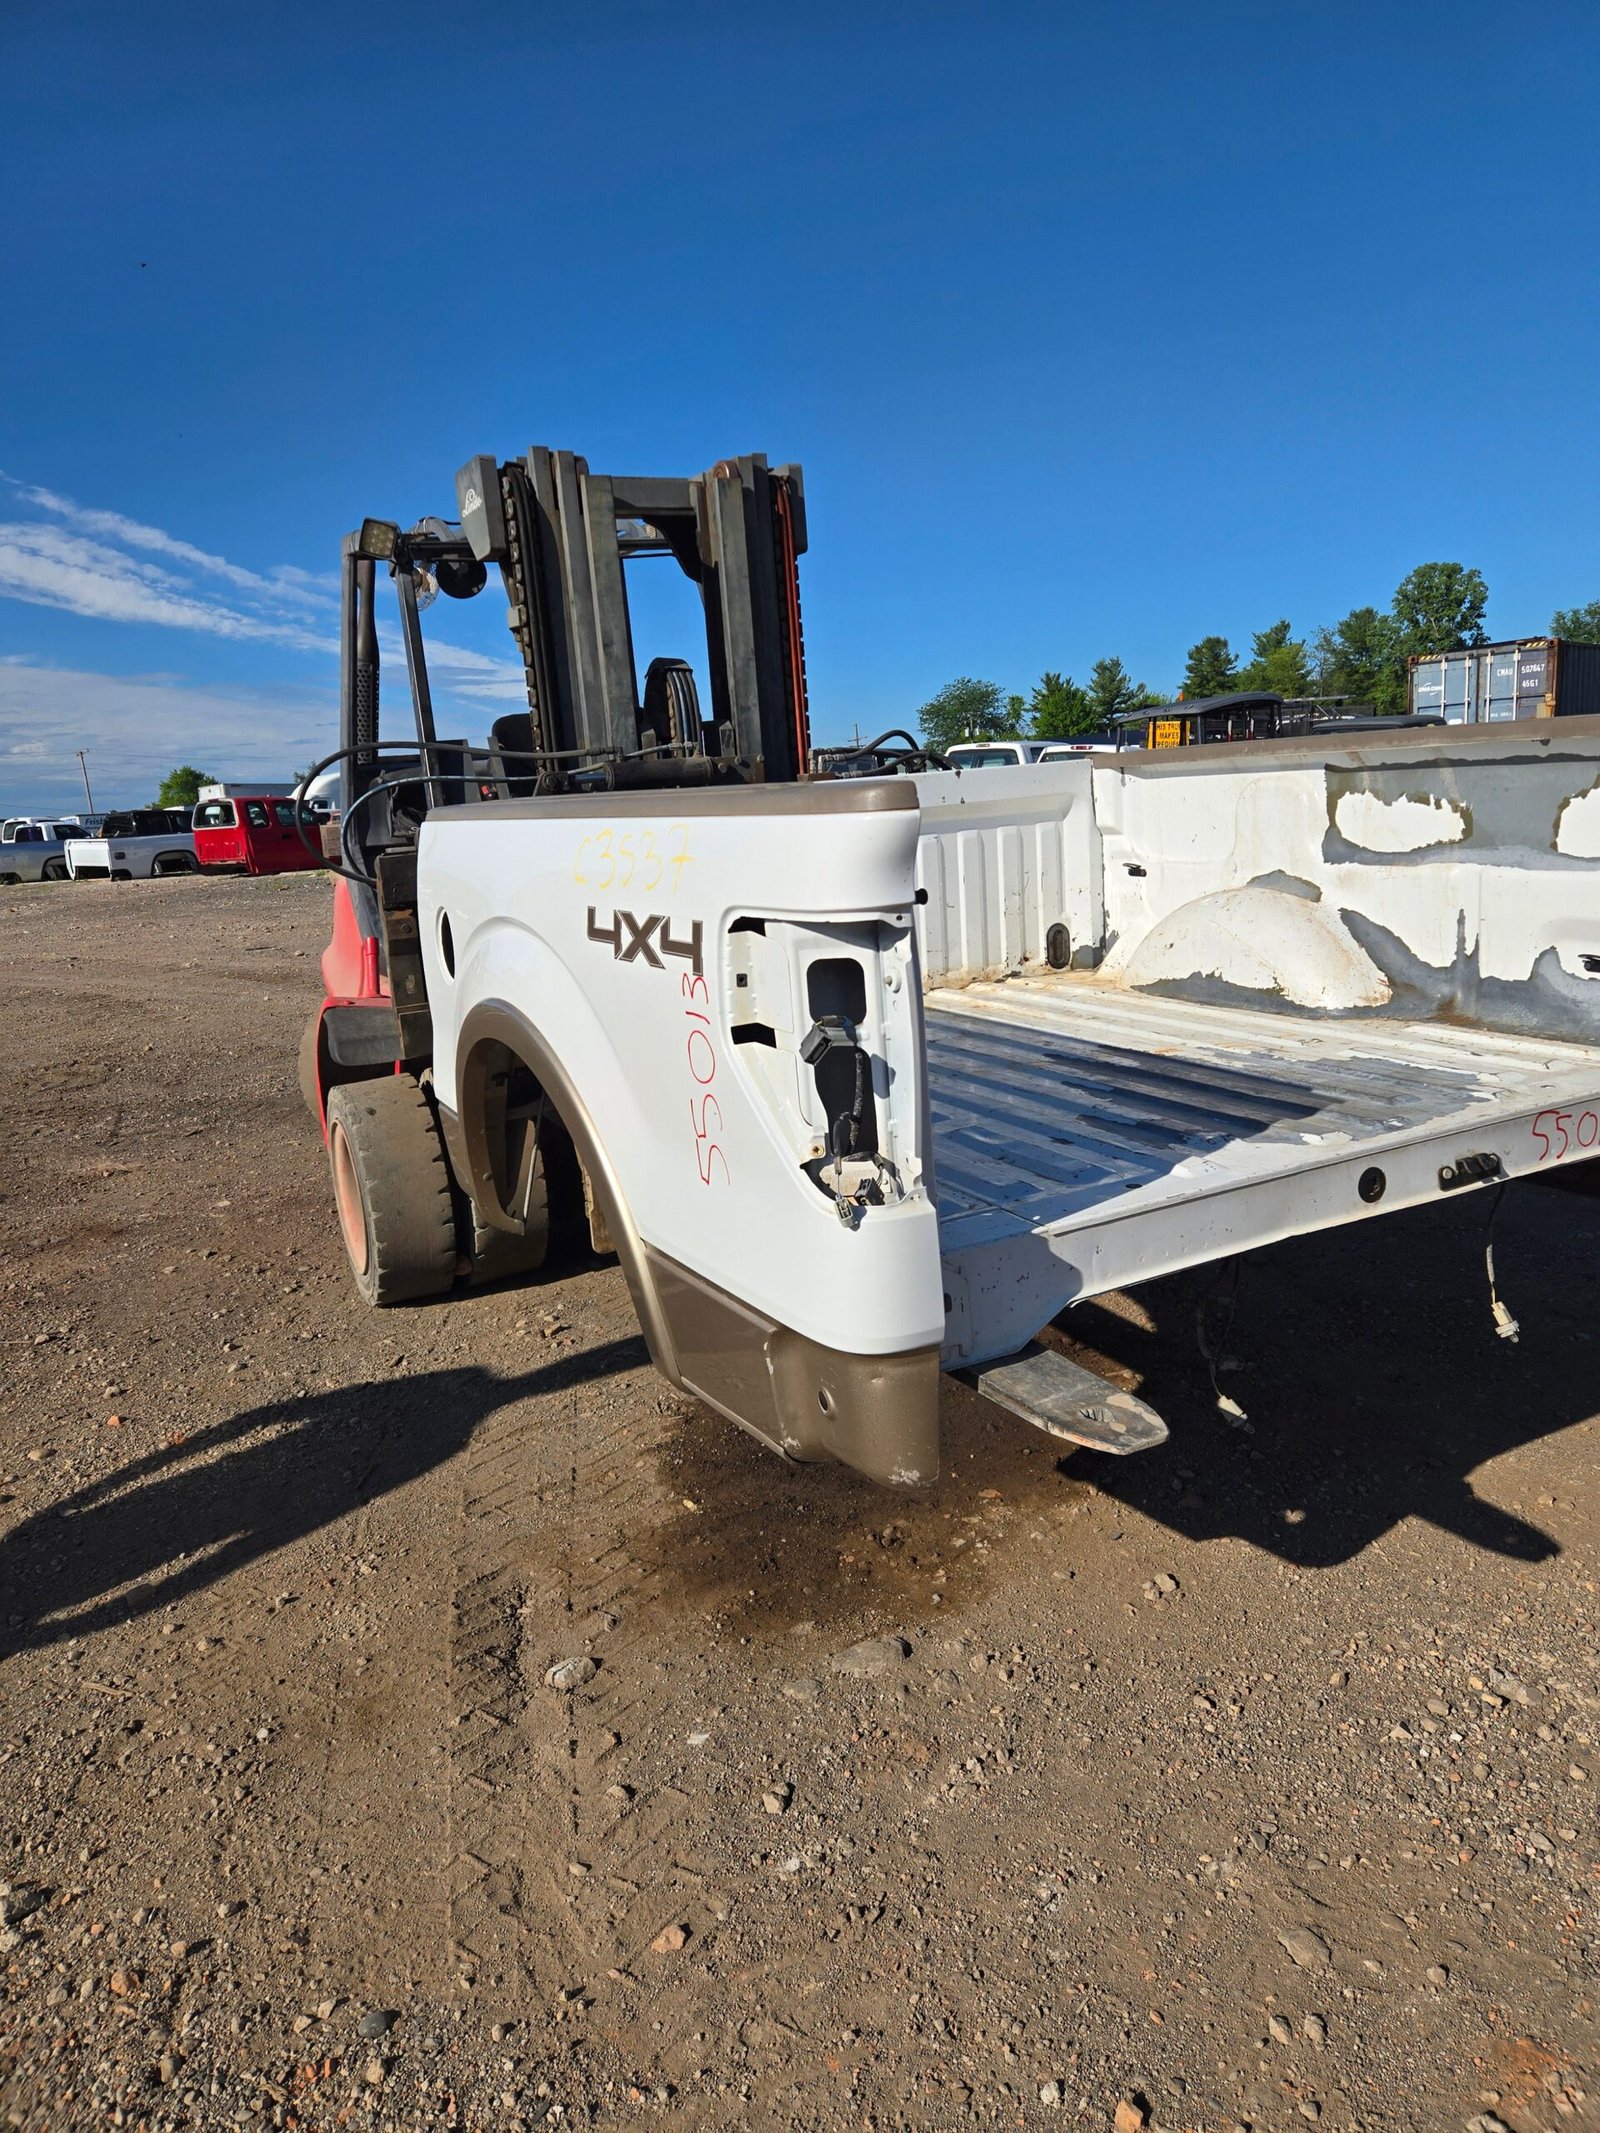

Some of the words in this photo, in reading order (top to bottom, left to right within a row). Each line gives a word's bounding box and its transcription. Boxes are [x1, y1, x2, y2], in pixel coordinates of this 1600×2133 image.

[587, 905, 703, 977] 4X4
[681, 972, 731, 1186] 55013
[1532, 1110, 1599, 1161] 550
